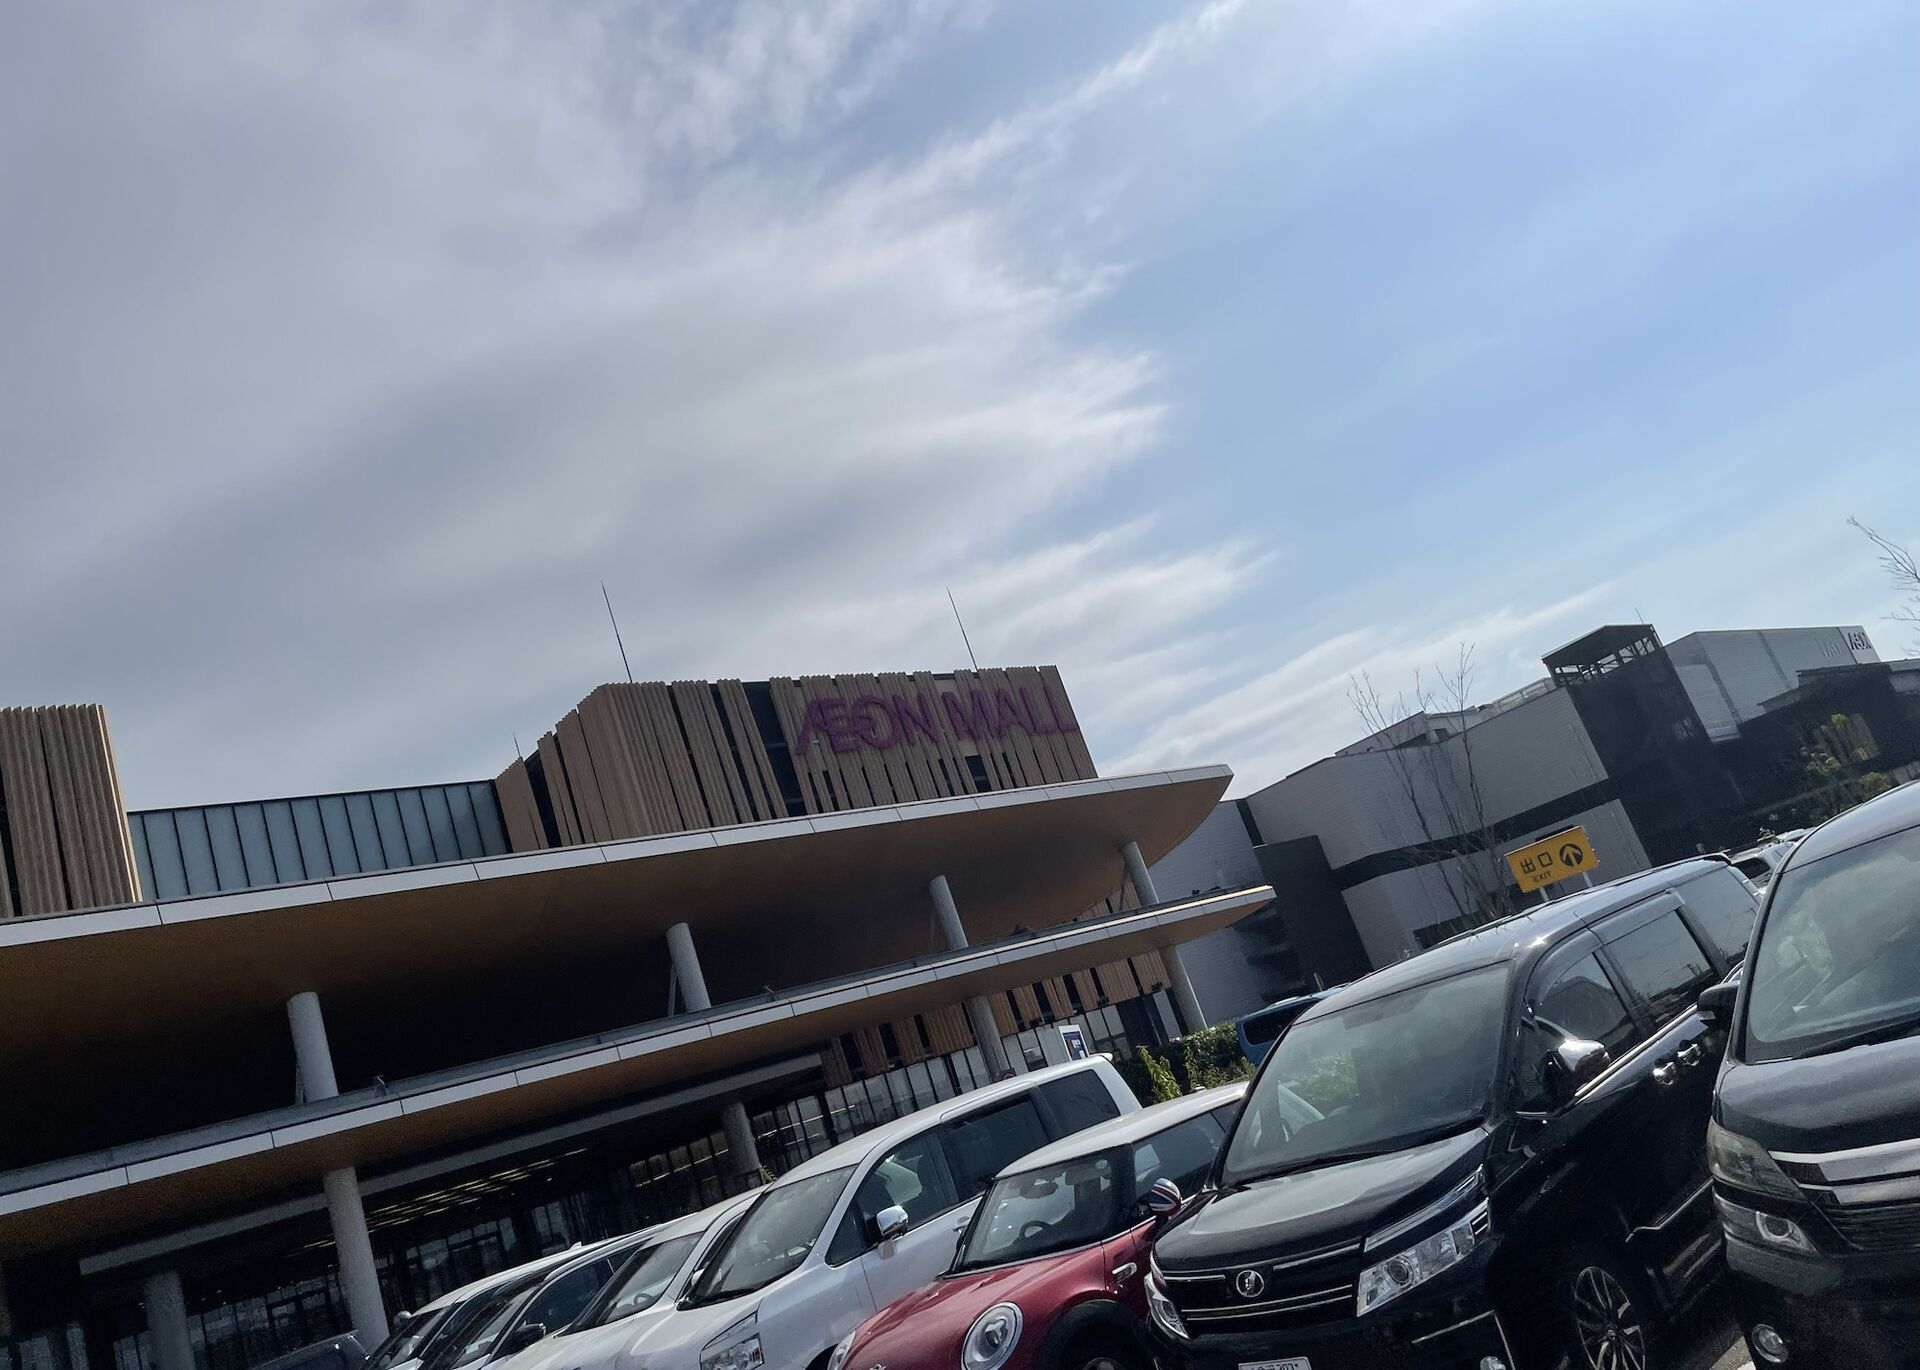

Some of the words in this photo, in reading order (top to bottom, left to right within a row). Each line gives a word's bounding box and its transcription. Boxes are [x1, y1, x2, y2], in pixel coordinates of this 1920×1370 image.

[941, 686, 1079, 743] MALL
[1520, 851, 1553, 874] 出口
[1532, 870, 1552, 883] EXIT
